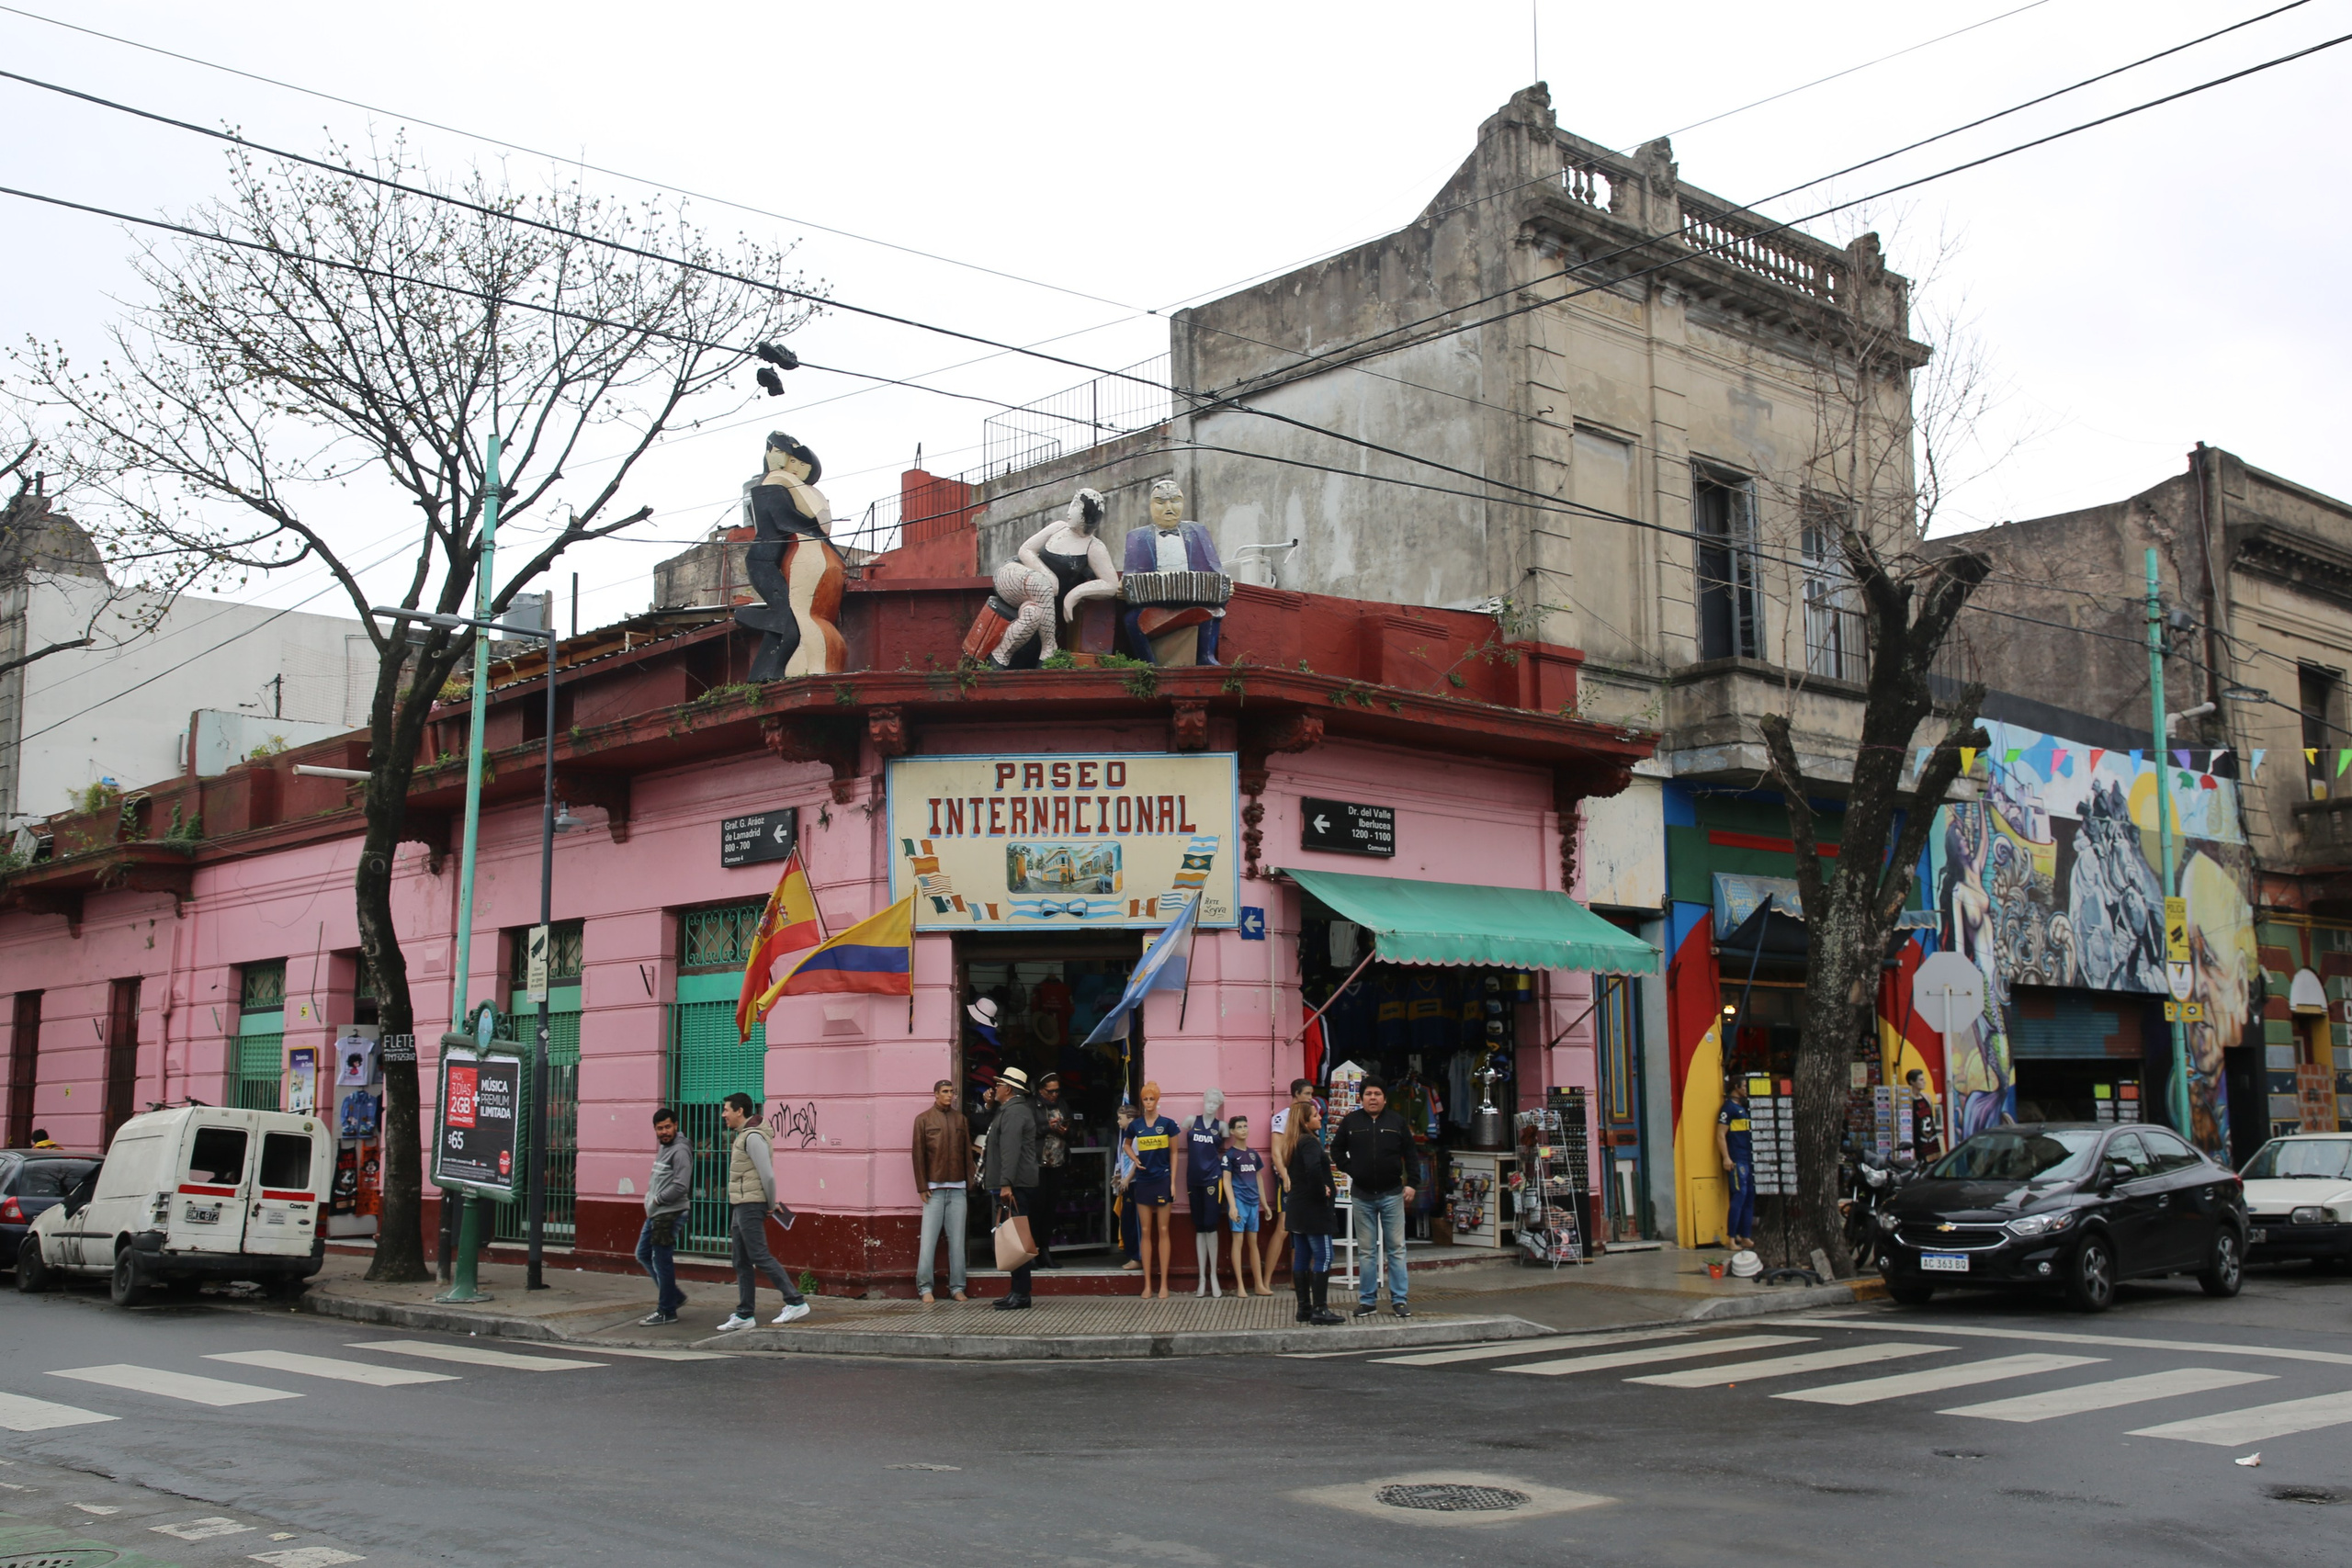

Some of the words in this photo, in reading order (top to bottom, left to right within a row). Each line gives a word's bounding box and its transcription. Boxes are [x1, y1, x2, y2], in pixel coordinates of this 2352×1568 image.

[994, 761, 1126, 791] PASEO
[926, 795, 1197, 838] INTERNACIONAL
[1348, 806, 1359, 816] Dr.
[1361, 807, 1372, 817] del
[1374, 809, 1391, 818] Valle
[740, 818, 747, 828] G.
[1358, 818, 1391, 830] Iberlucea
[724, 832, 732, 841] de
[733, 828, 761, 840] Lamadrid
[1351, 829, 1369, 839] 1200
[1374, 831, 1391, 841] 1100
[724, 842, 735, 852] 800
[740, 840, 751, 850] 700
[384, 1034, 414, 1048] FLETE
[481, 1077, 508, 1093] MÚSICA
[481, 1093, 510, 1107] PREMIUM
[480, 1105, 512, 1119] ILIMITADA
[447, 1130, 464, 1150] $65
[1193, 1134, 1214, 1145] BBVA
[1240, 1164, 1256, 1173] BBVA
[289, 1202, 310, 1211] Courier
[204, 1212, 219, 1222] 872
[1923, 1258, 1934, 1269] AC
[1936, 1259, 1953, 1269] 363
[1955, 1259, 1967, 1269] BQ
